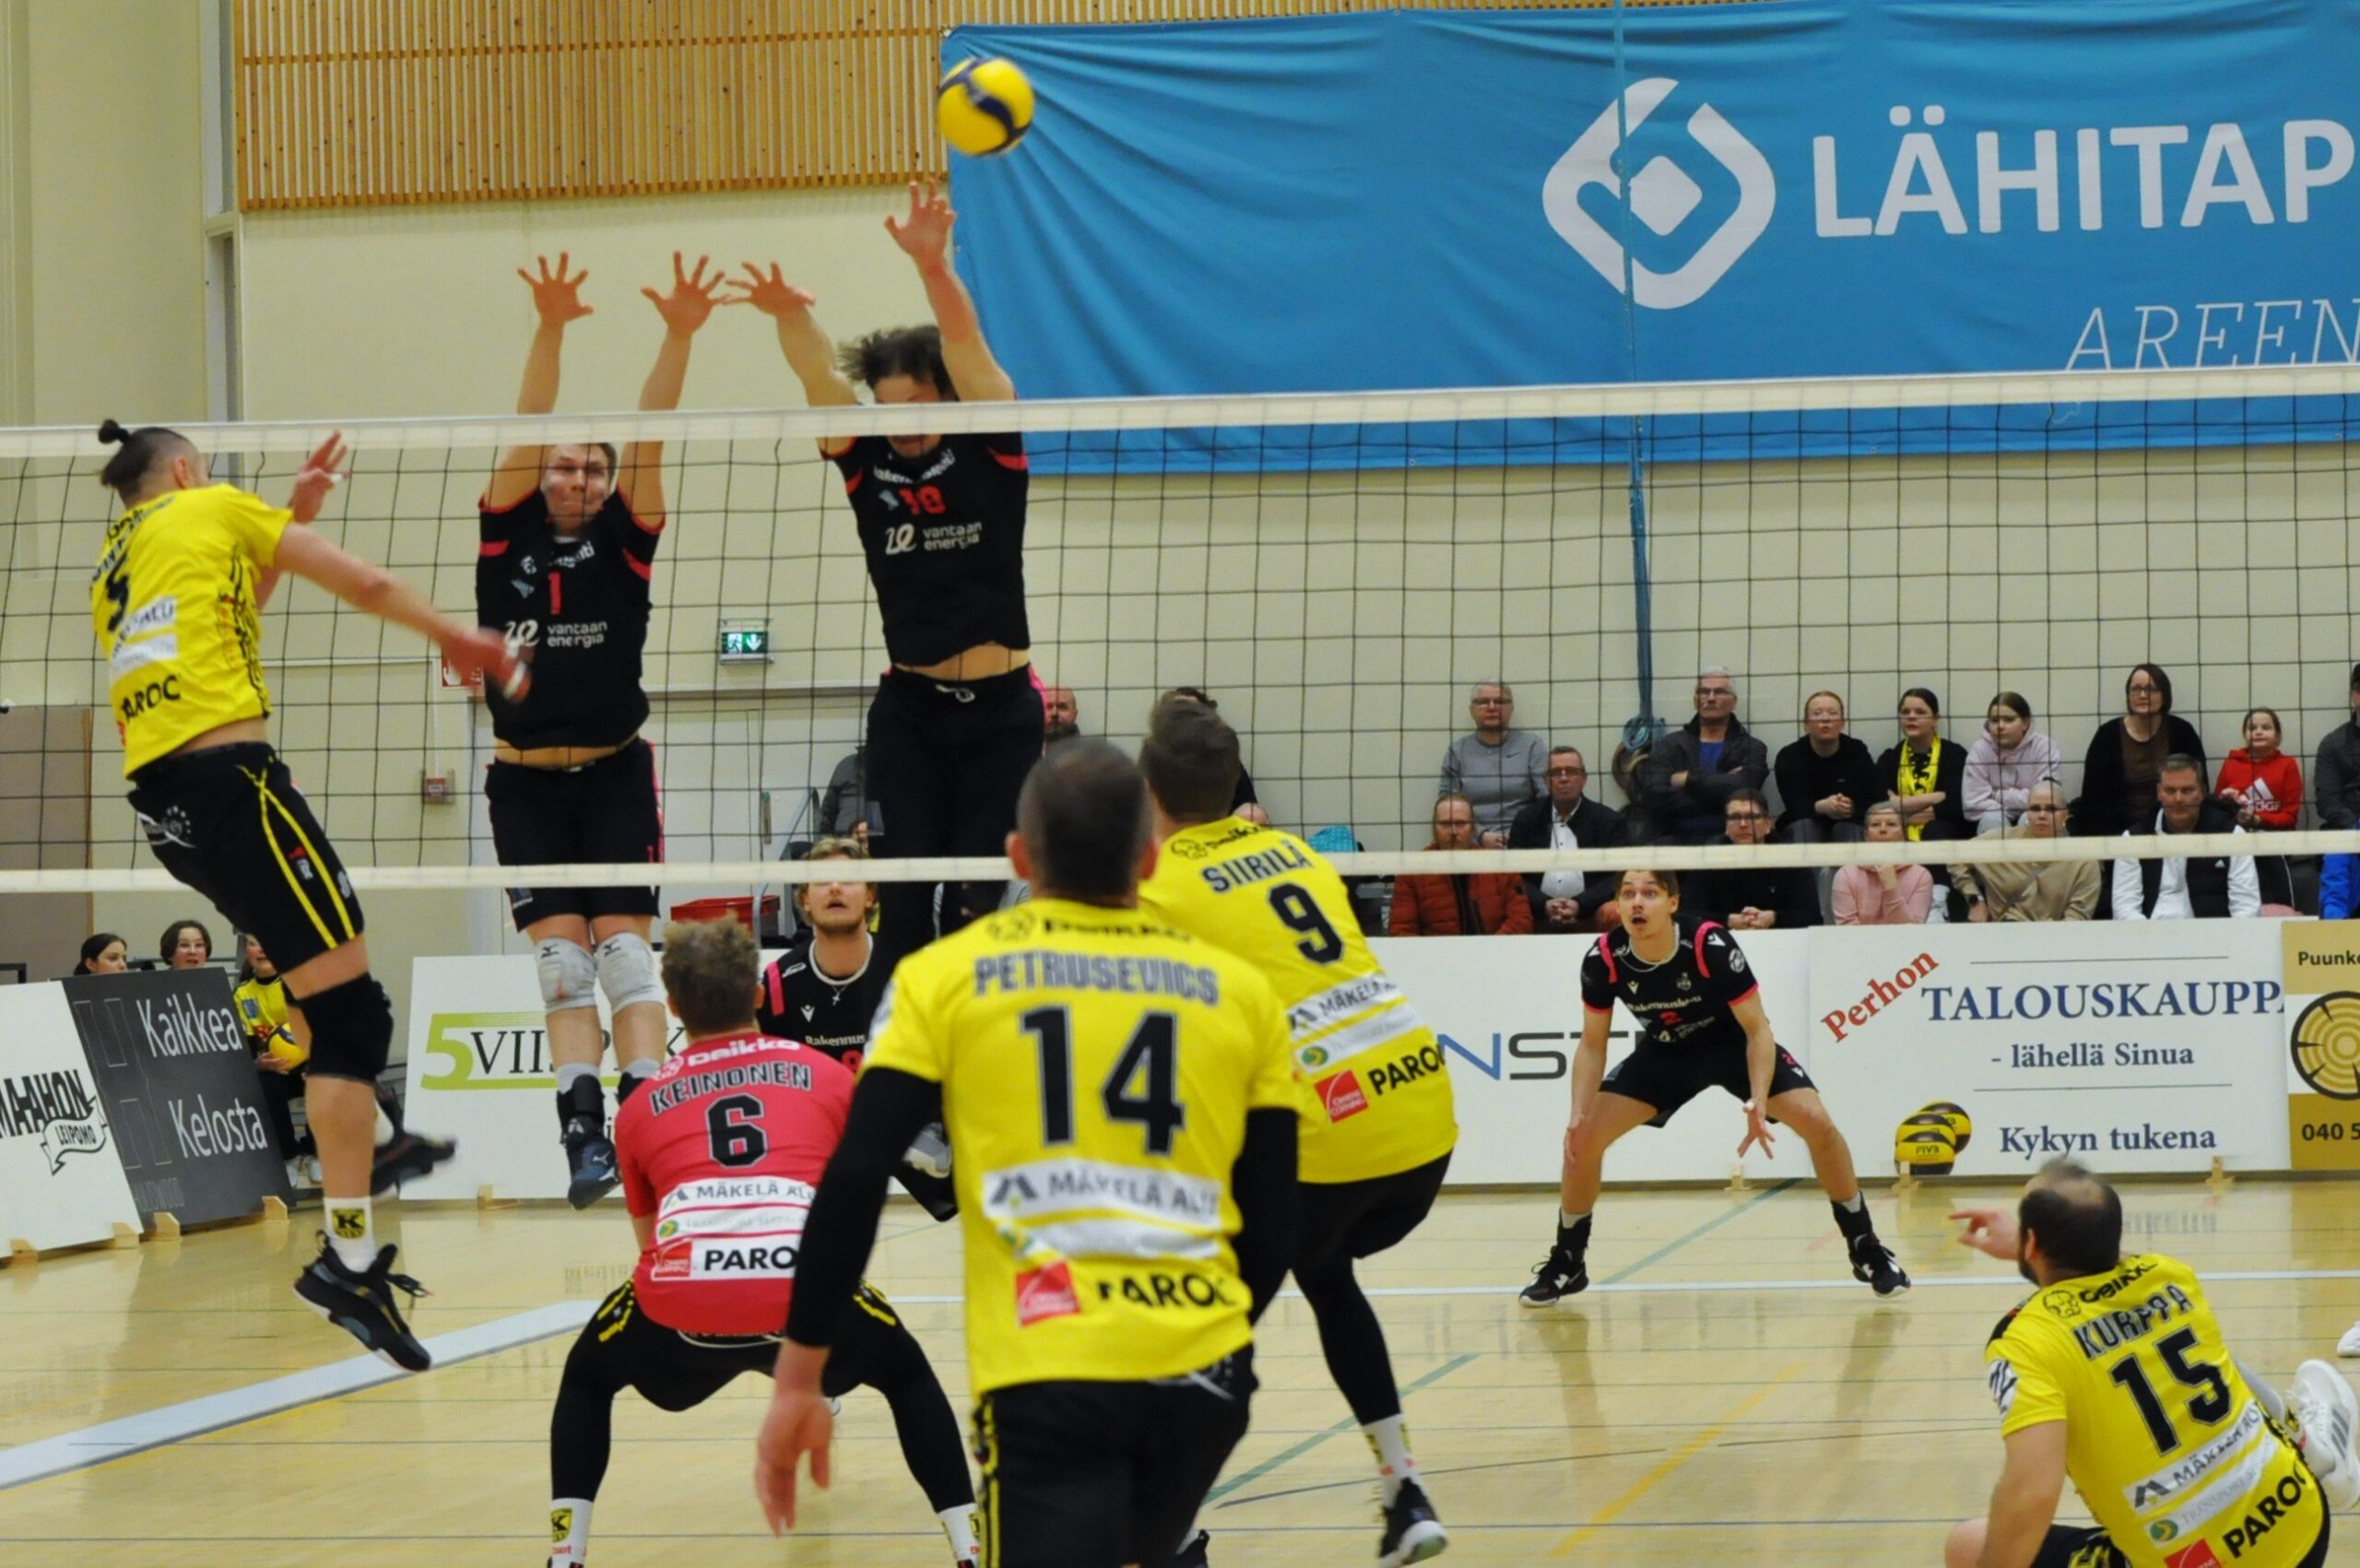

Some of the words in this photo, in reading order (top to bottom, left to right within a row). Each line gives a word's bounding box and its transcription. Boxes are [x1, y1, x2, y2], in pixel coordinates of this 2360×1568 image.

[1812, 104, 2355, 237] LÄHITAP
[923, 521, 983, 540] vantaan
[548, 571, 562, 615] 1
[547, 621, 608, 635] vantaan
[547, 632, 605, 648] energia
[120, 675, 182, 722] AROC
[1201, 838, 1315, 893] SIIRILÄ
[1268, 880, 1345, 966] 9
[974, 949, 1219, 1008] PETRUSEVICS
[1820, 949, 1940, 1043] Perhon
[1921, 979, 2284, 1021] TALOUSKAUPP
[136, 992, 242, 1058] Kaikkea
[1018, 1004, 1186, 1158] 14
[2012, 1042, 2105, 1069] lähellä
[2115, 1043, 2195, 1067] Sinua
[650, 1061, 813, 1117] KEINONEN
[55, 1125, 97, 1146] LEIPOMO
[168, 1093, 268, 1159] Kelosta
[705, 1092, 768, 1169] 6
[2000, 1126, 2099, 1160] Kykyn
[2109, 1124, 2217, 1151] tukena
[2302, 1123, 2344, 1141] 040
[697, 1180, 779, 1199] MÄKELÄ
[703, 1245, 799, 1271] PARO
[2072, 1282, 2195, 1362] KURPPA
[2108, 1325, 2234, 1457] 15
